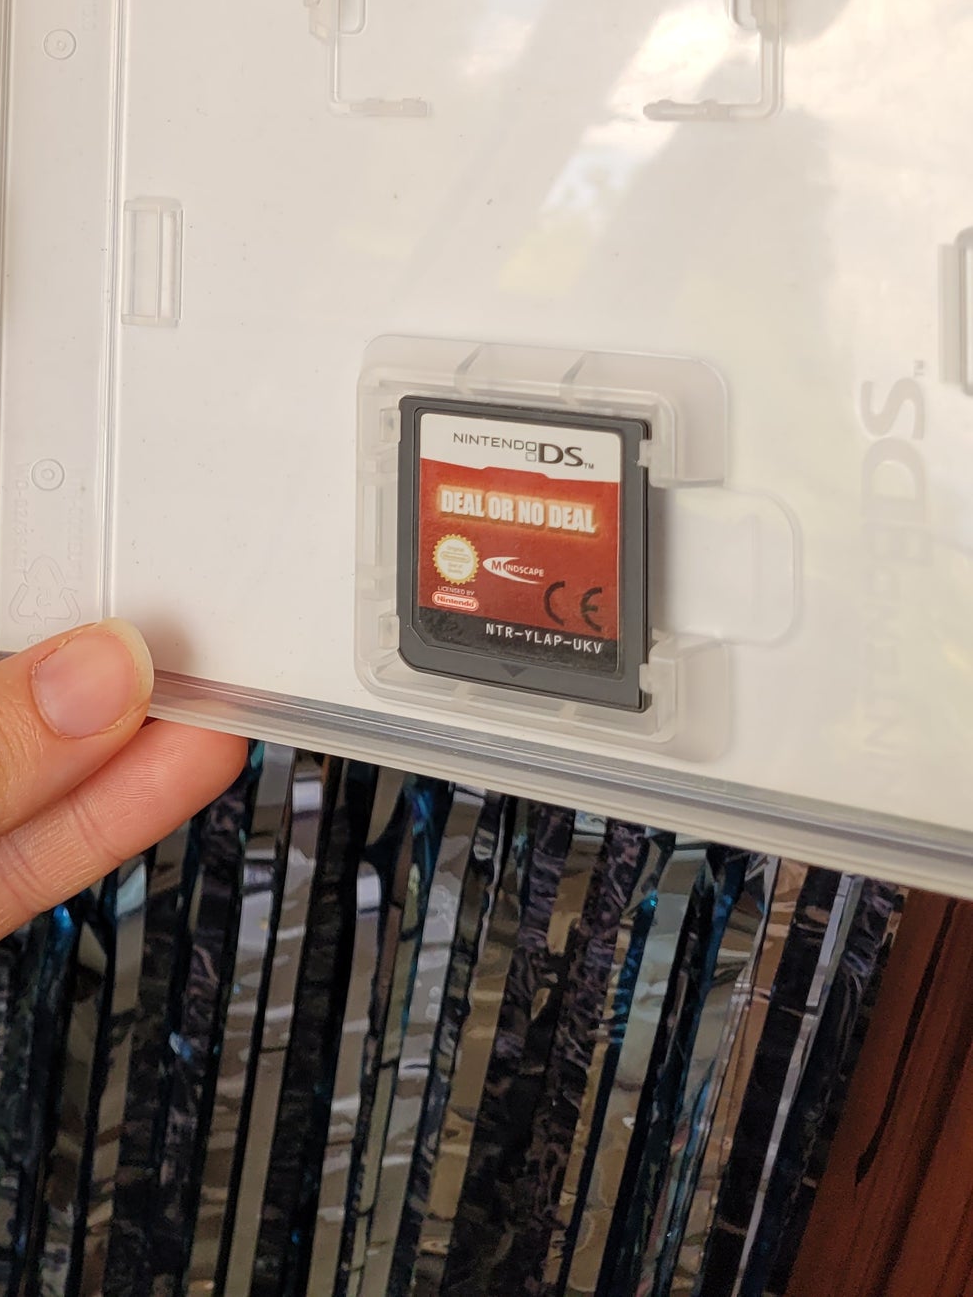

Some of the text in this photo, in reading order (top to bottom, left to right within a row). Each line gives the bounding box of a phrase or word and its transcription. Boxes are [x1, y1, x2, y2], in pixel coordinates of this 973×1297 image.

[452, 432, 537, 452] NINTENDO
[538, 442, 584, 467] DS
[440, 488, 596, 534] DEAL OR NO DEAL
[490, 560, 545, 578] MINDSCAPE
[437, 595, 474, 607] Nintendo
[485, 622, 603, 655] NTR-YLAP-UKV
